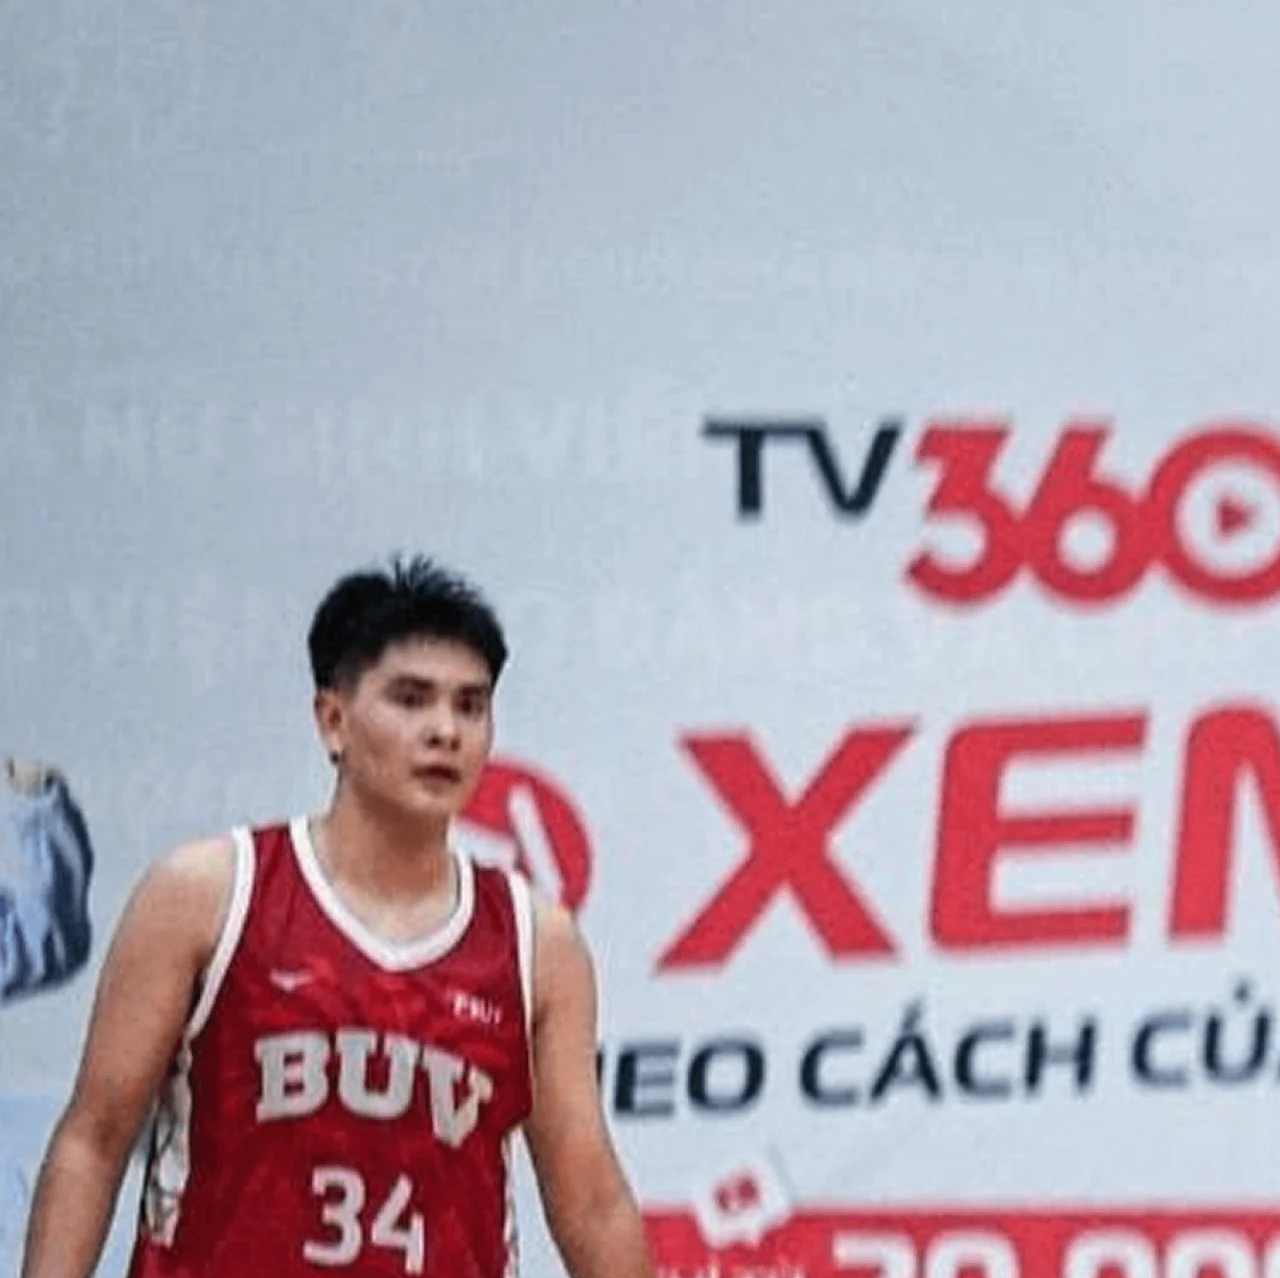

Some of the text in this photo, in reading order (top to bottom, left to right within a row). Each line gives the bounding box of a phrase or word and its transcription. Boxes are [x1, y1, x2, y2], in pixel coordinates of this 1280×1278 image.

[254, 1025, 493, 1149] BUV
[596, 1036, 767, 1117] EO
[799, 996, 1098, 1109] CÁCH
[303, 1165, 425, 1275] 34
